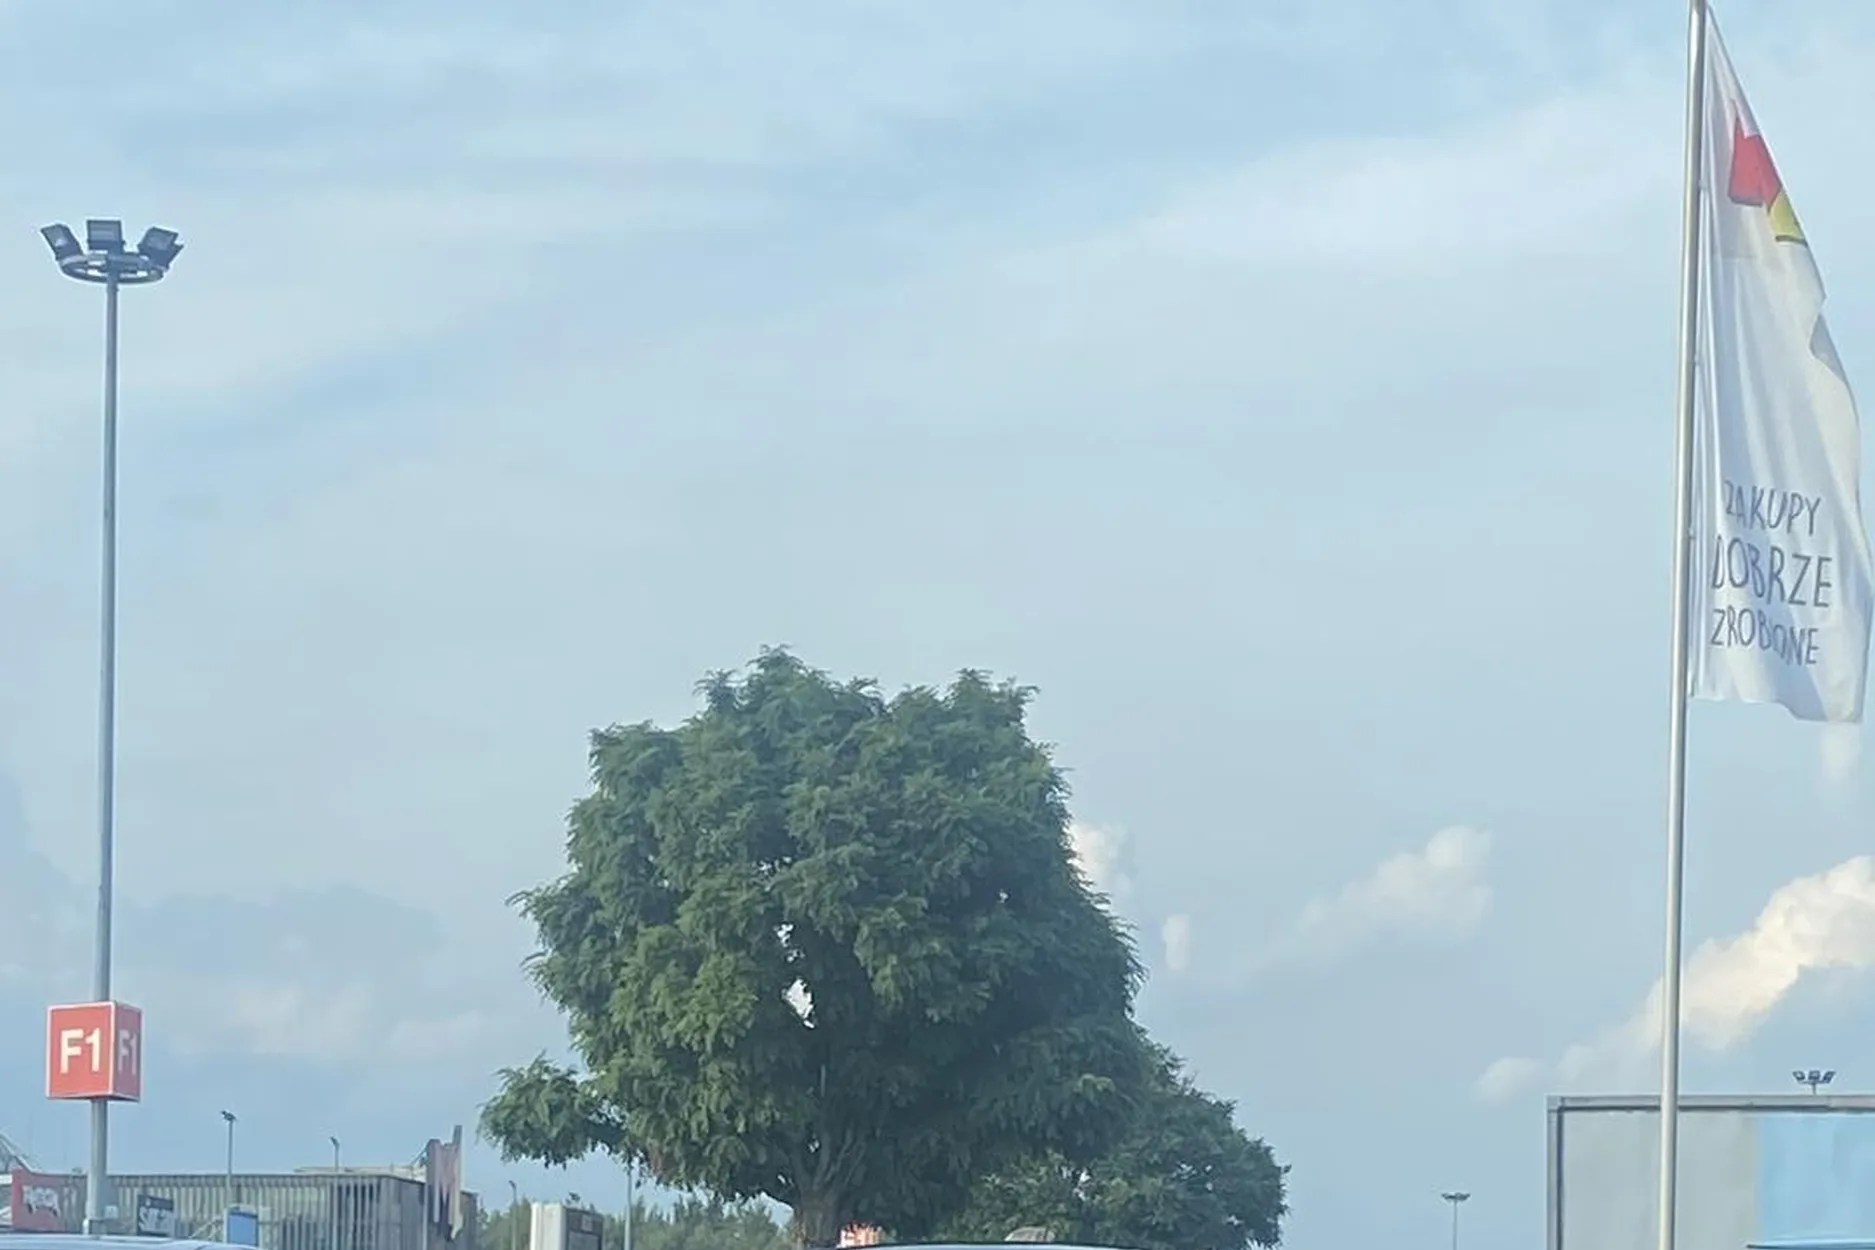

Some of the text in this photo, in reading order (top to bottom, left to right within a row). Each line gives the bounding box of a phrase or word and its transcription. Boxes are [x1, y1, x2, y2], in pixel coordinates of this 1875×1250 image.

[1724, 480, 1821, 536] ZAKUPY
[1711, 535, 1833, 608] DOBRZE
[1711, 605, 1819, 665] ZROBONE
[60, 1027, 101, 1075] F1
[117, 1028, 138, 1076] F1
